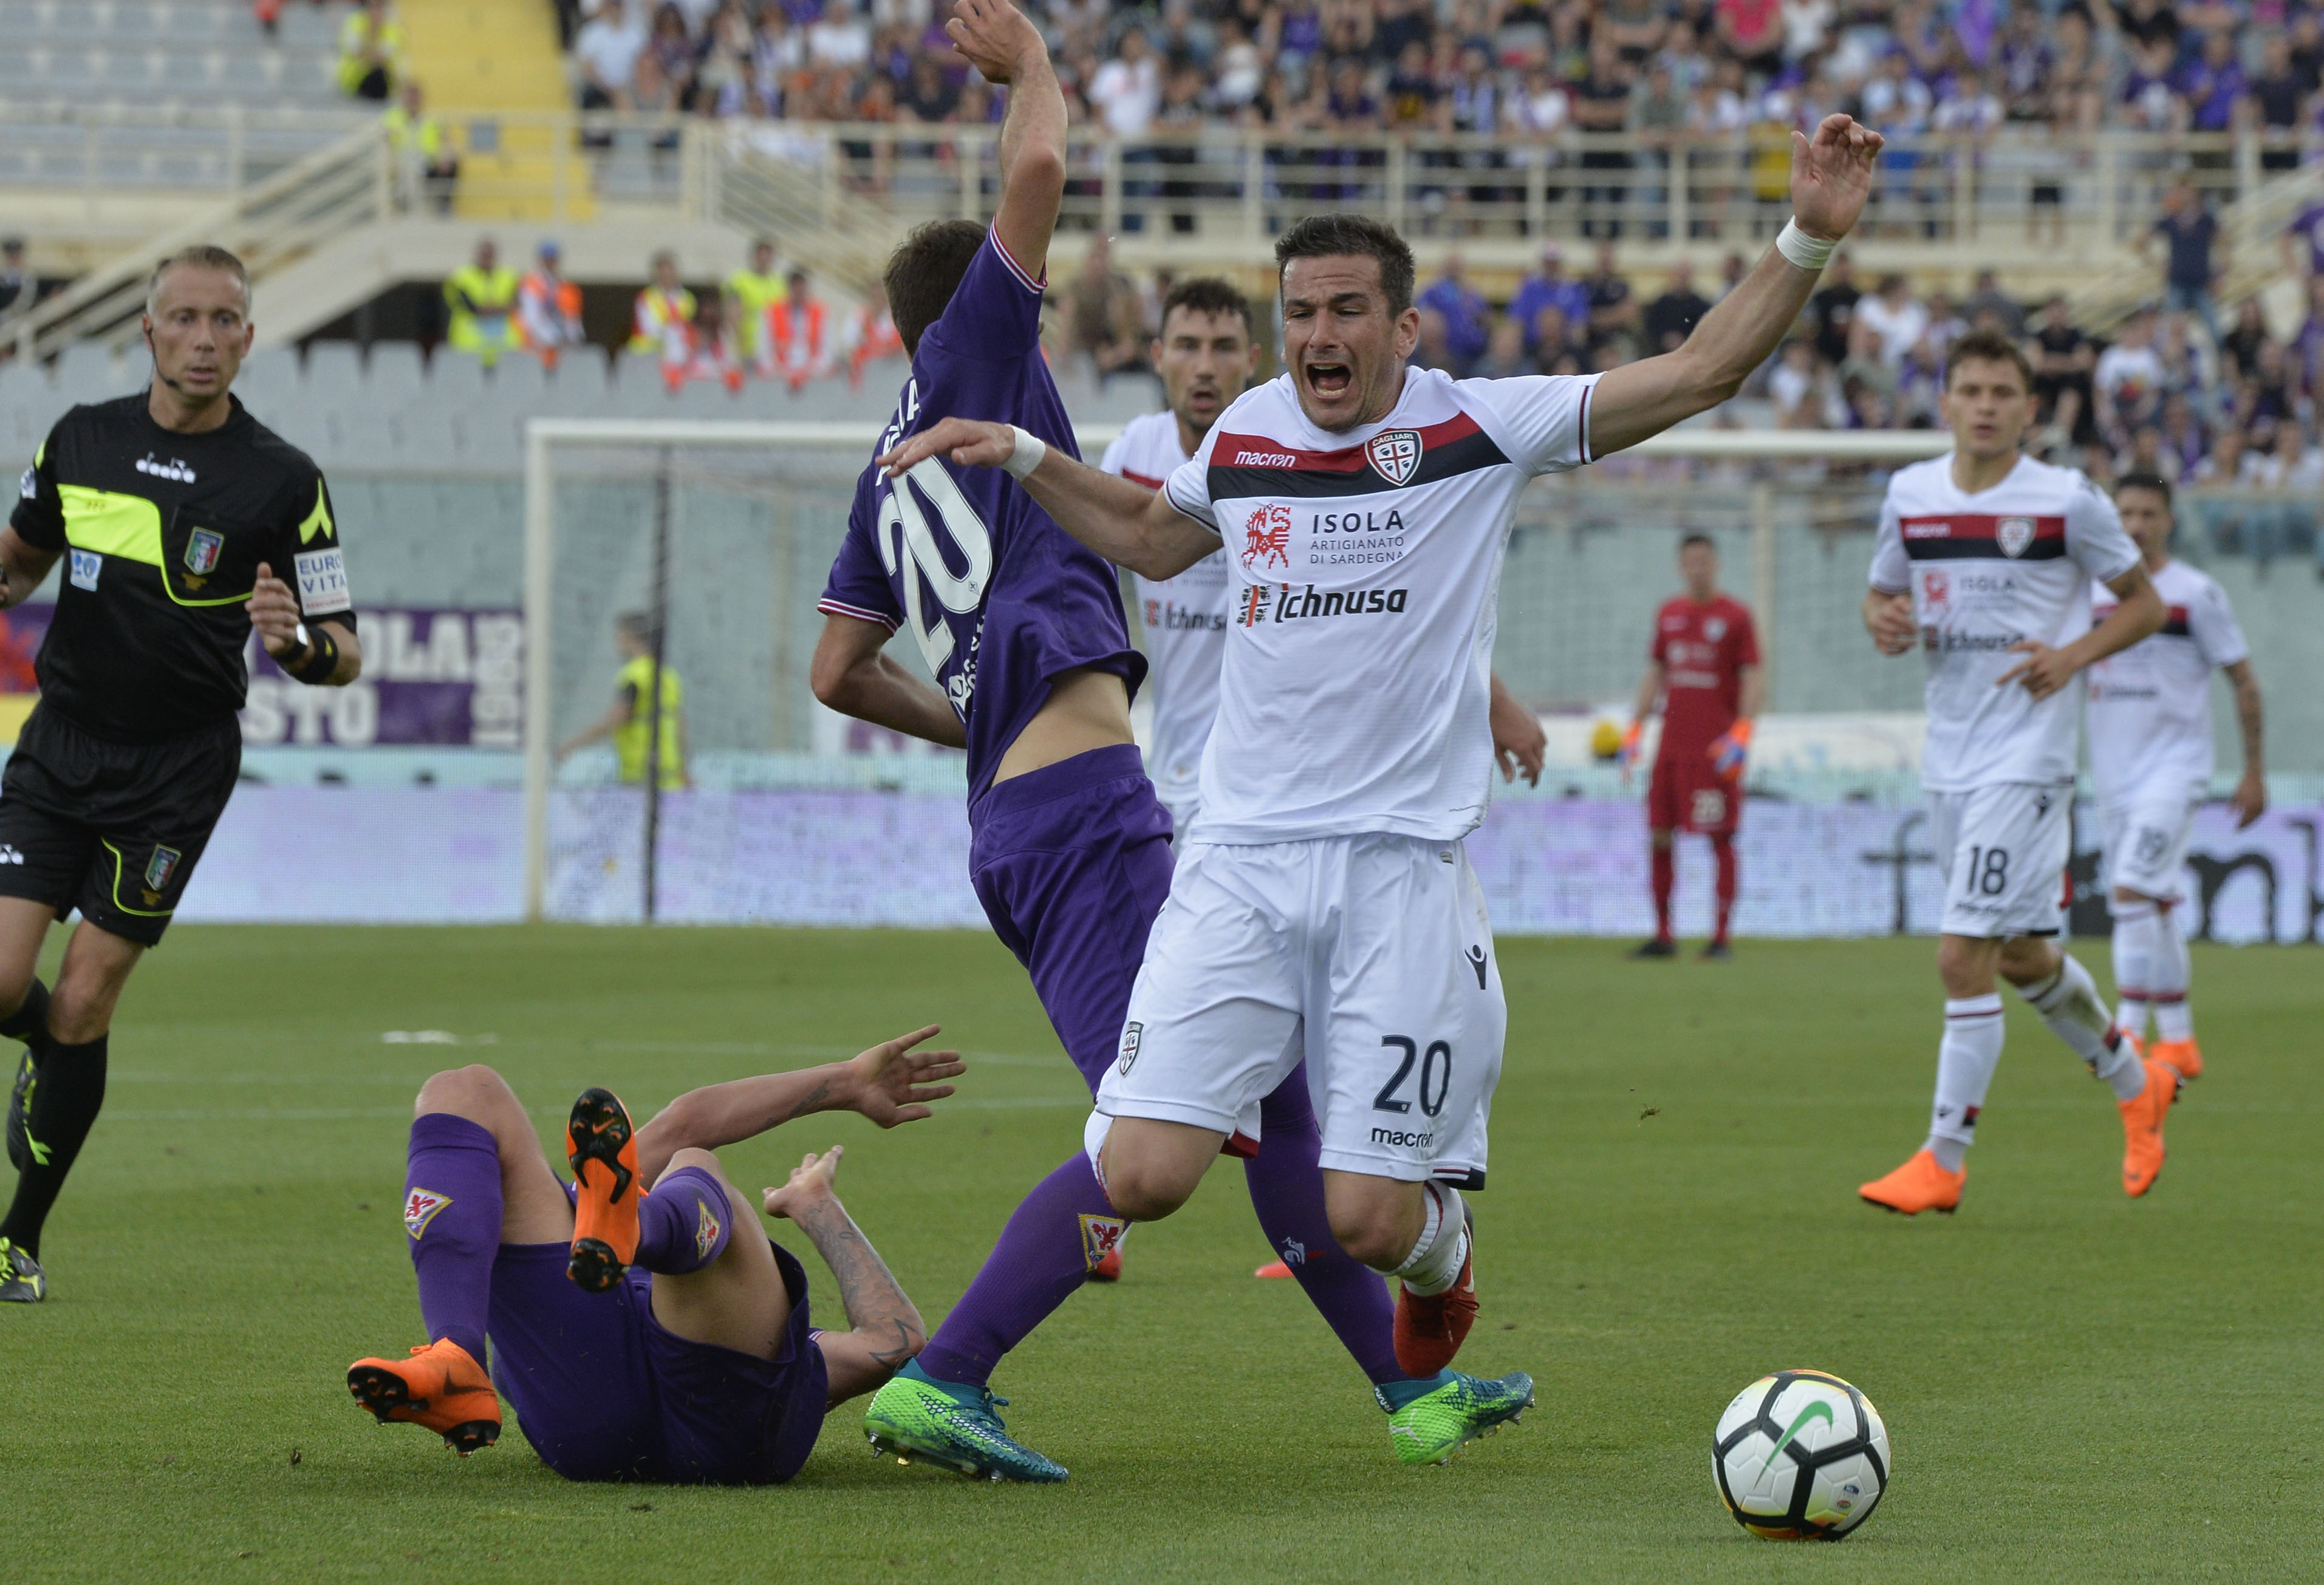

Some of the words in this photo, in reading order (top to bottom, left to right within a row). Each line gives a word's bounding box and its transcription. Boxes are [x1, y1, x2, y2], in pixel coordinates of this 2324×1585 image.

[1372, 433, 1414, 447] CAGLIARI
[1234, 451, 1296, 467] macron
[1313, 510, 1405, 534] ISOLA
[1310, 536, 1404, 550] ARTIGIANATO
[298, 554, 342, 575] EURO
[878, 454, 992, 680] 20
[1310, 554, 1324, 564] DI
[1330, 551, 1404, 565] SARDEGNA
[1967, 845, 2008, 895] 18
[1372, 1034, 1452, 1118] 20
[1371, 1127, 1433, 1148] macron
